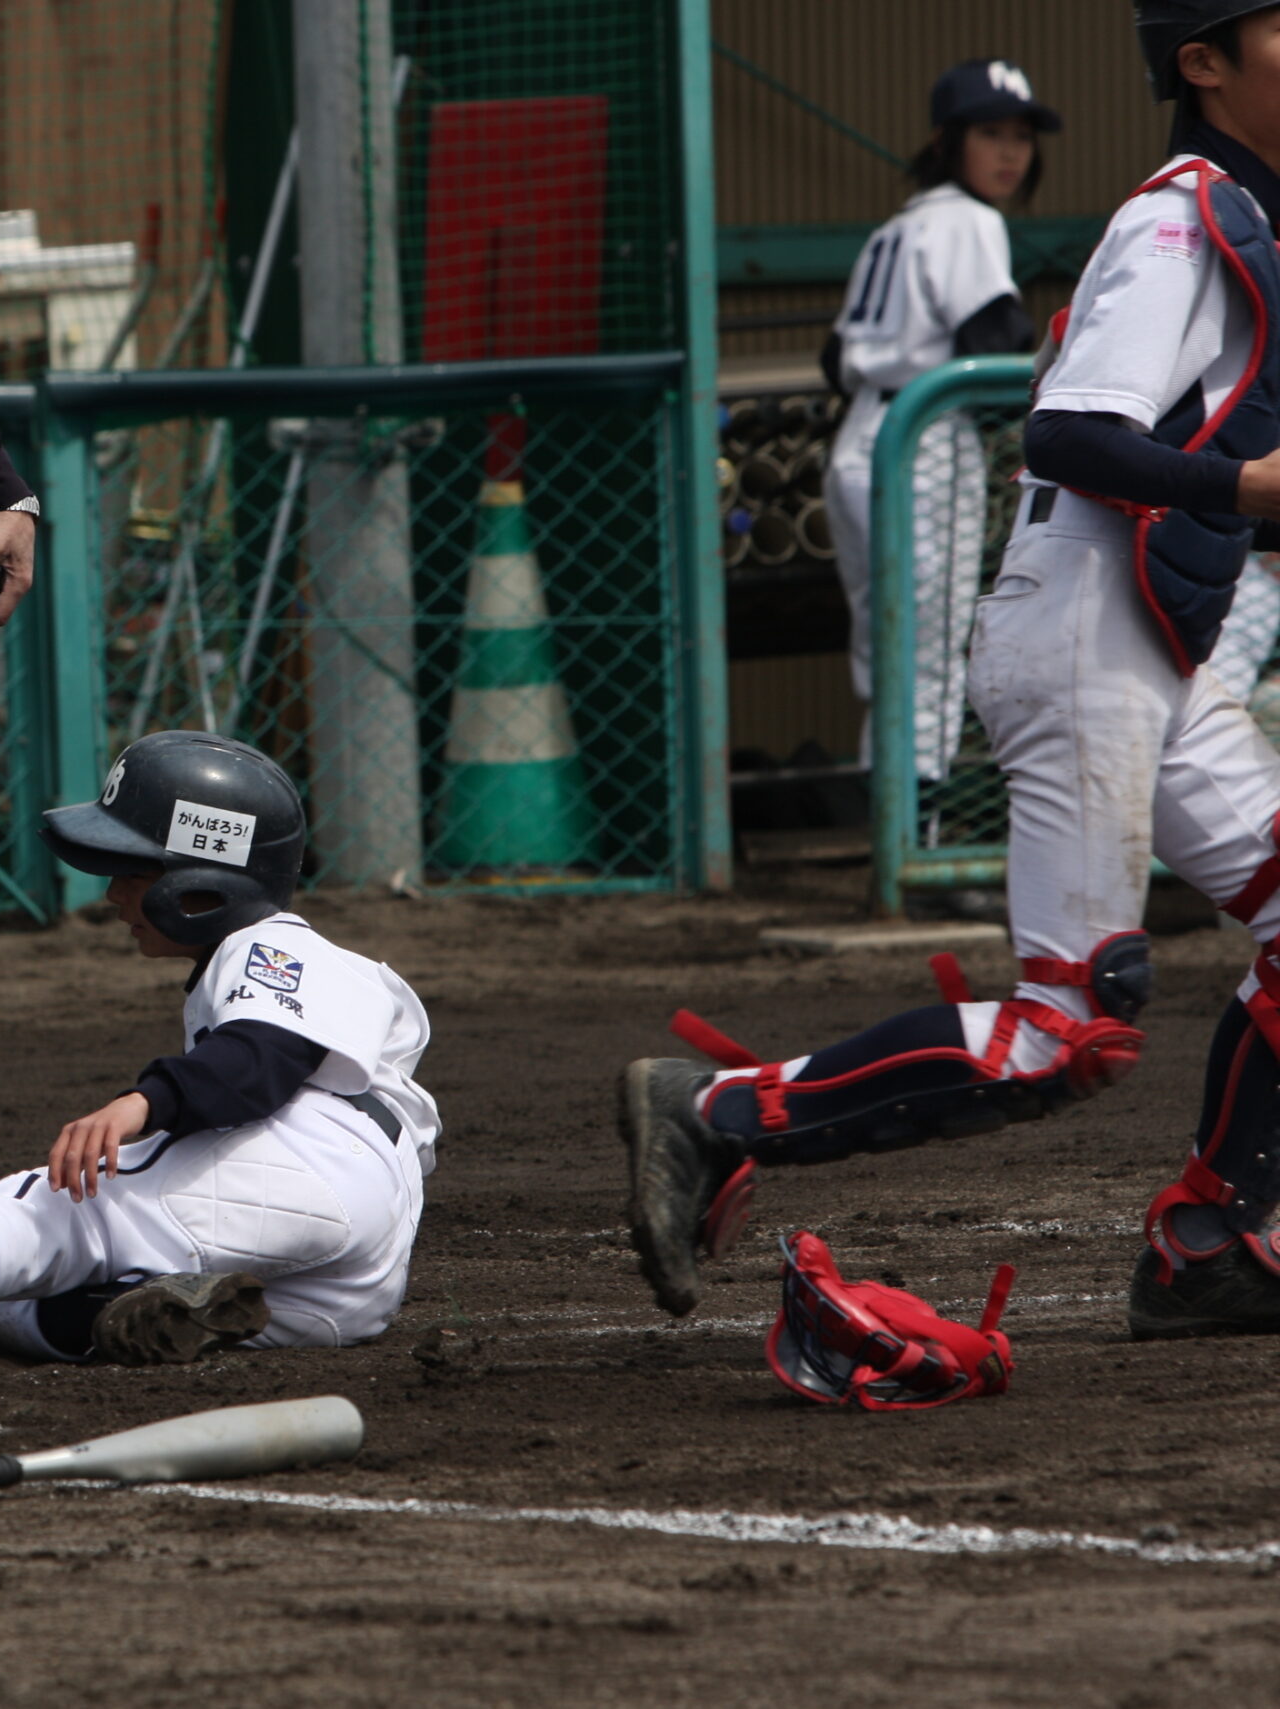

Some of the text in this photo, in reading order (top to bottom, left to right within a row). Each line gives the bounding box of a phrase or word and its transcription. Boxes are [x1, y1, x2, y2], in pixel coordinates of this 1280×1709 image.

[178, 811, 249, 837] がんばろう!
[192, 834, 228, 853] 日本
